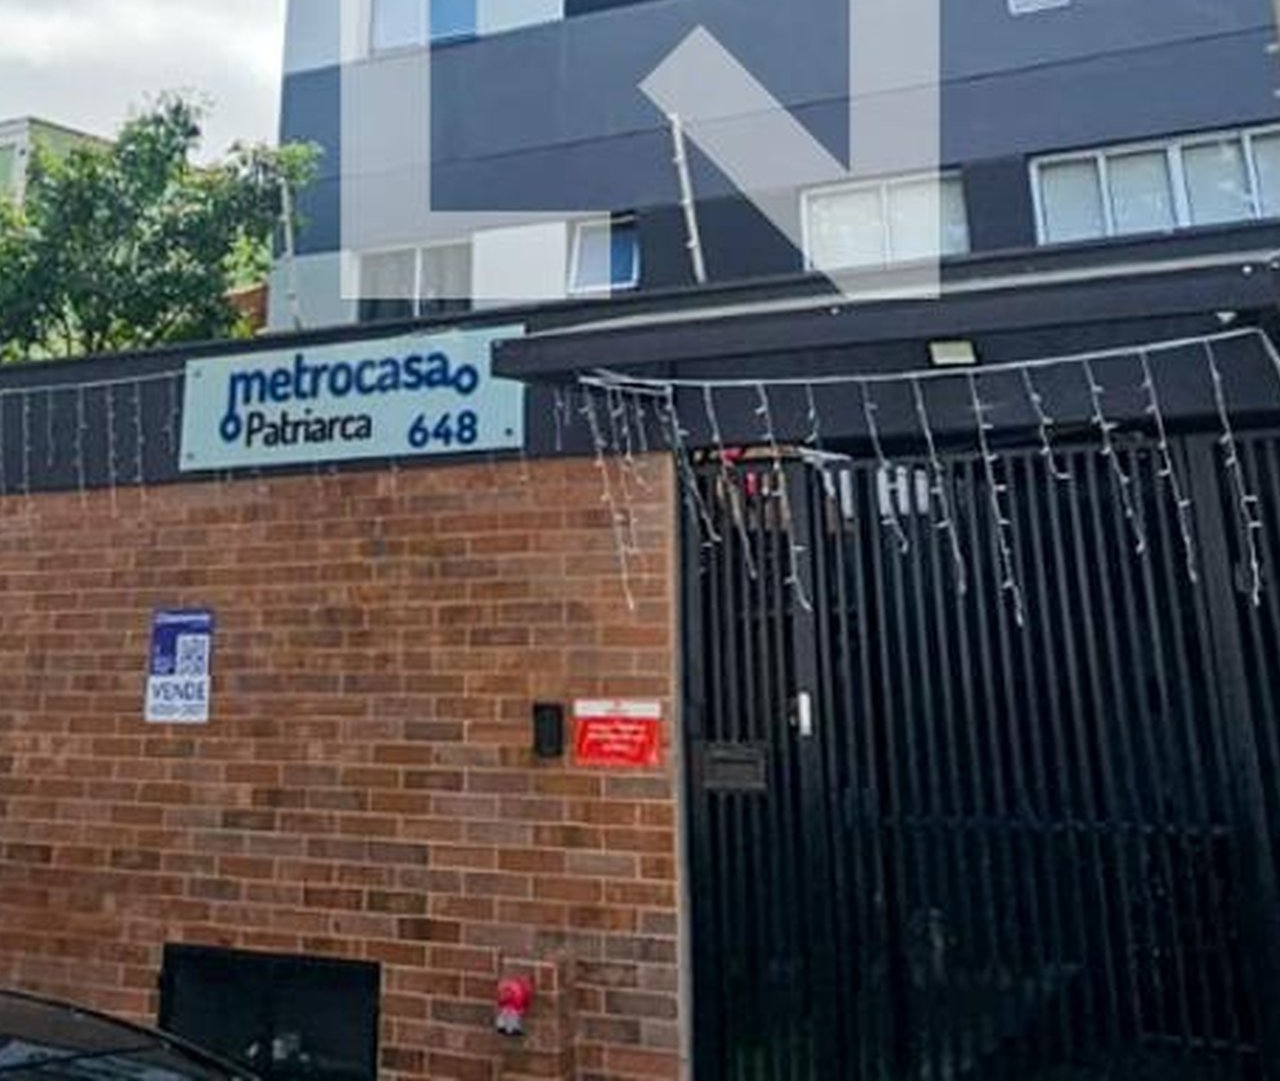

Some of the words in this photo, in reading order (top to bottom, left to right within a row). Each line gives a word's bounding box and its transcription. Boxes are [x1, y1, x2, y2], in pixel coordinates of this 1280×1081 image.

[228, 351, 455, 407] metrocasa
[246, 408, 372, 447] Patriarca
[408, 411, 479, 448] 648
[151, 681, 206, 702] VENDE
